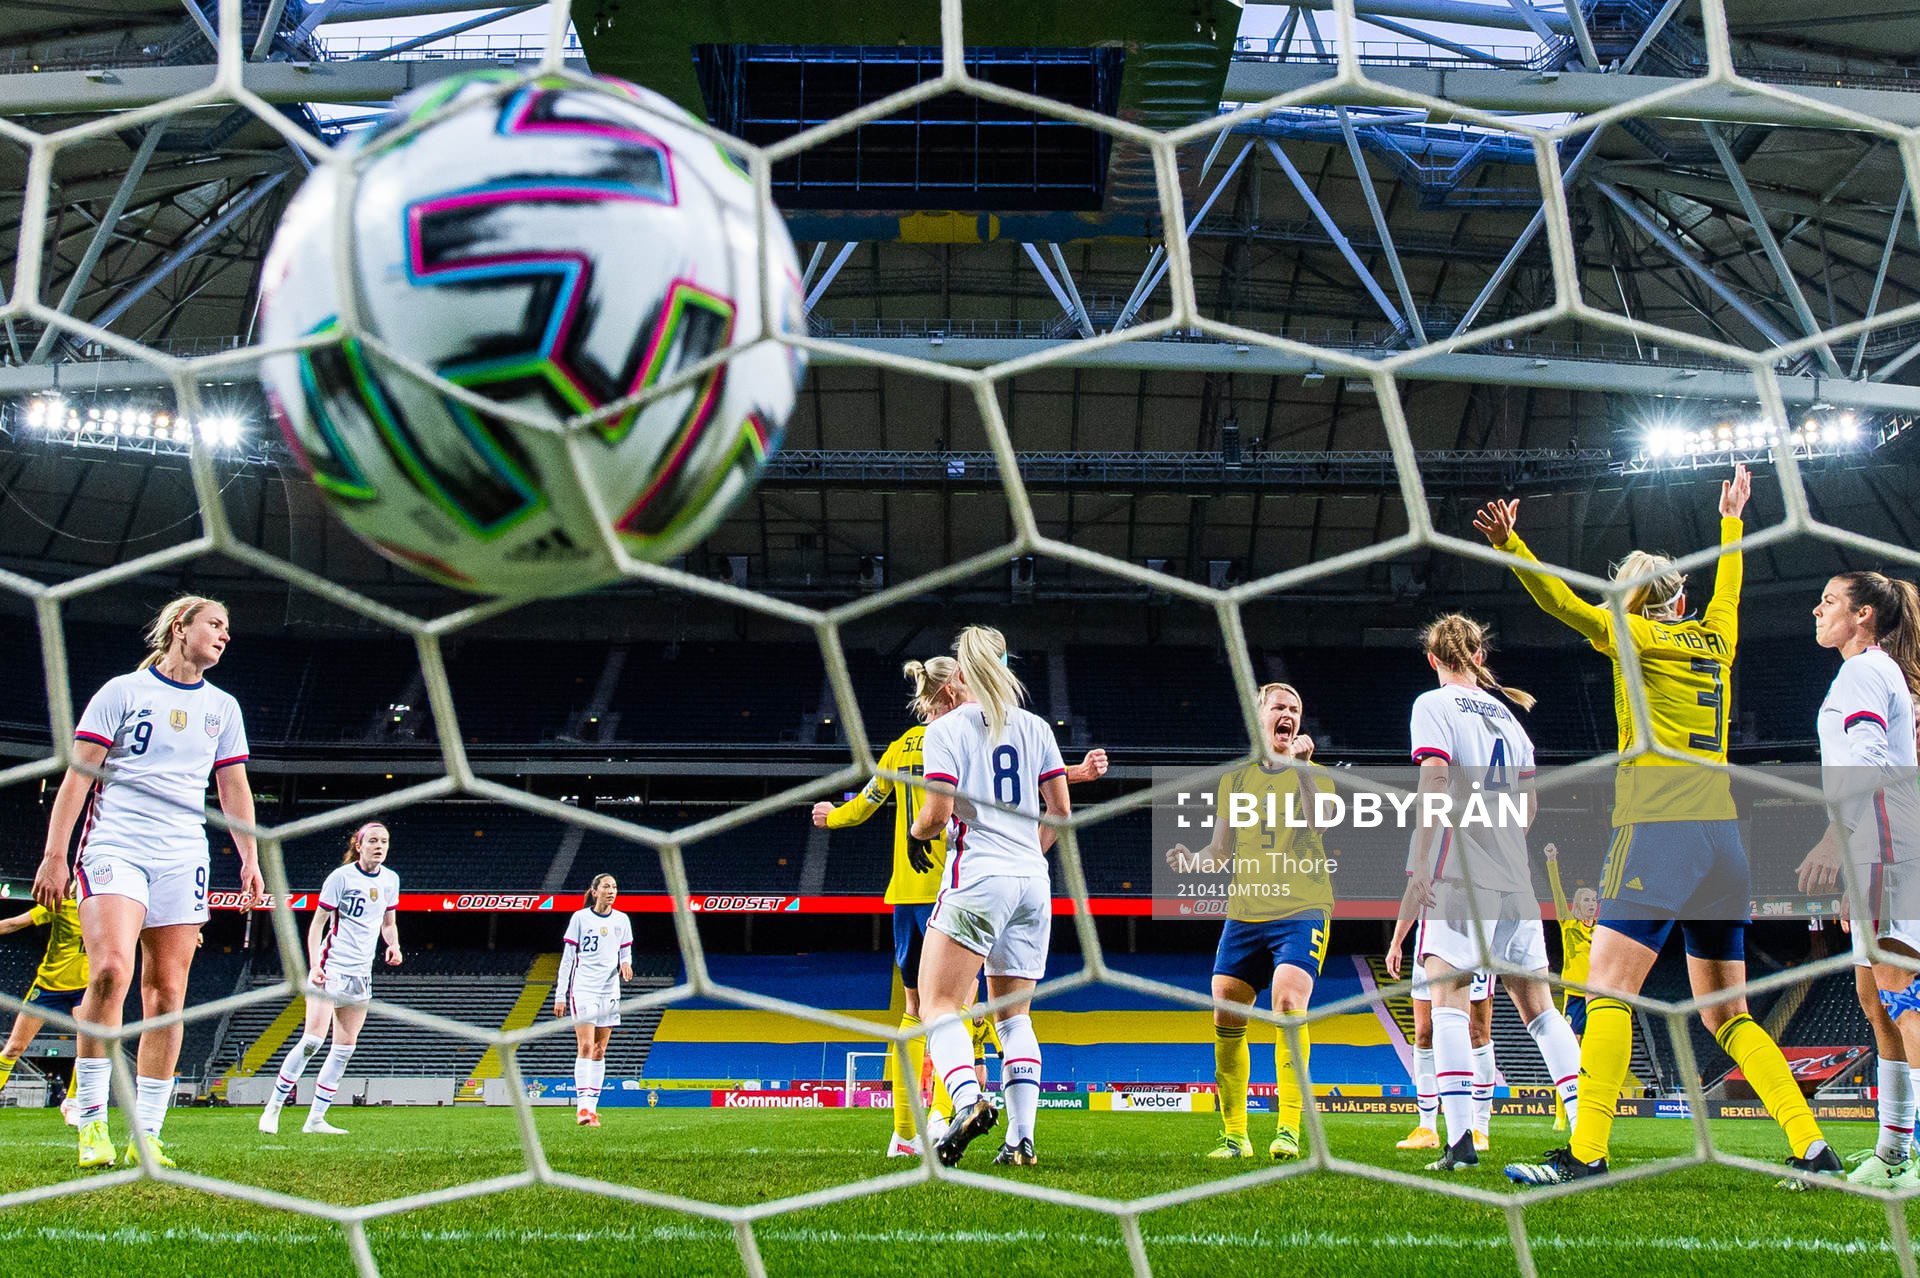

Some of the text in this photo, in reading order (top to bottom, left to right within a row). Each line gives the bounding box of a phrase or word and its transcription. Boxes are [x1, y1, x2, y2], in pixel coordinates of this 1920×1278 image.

[1689, 657, 1723, 751] 3
[131, 721, 153, 755] 9
[1484, 738, 1511, 791] 4
[992, 745, 1021, 809] 8
[194, 866, 206, 900] 9
[347, 897, 365, 917] 16
[457, 895, 538, 909] ODDSET
[704, 896, 785, 911] ODDSET
[1763, 902, 1793, 915] SWE
[583, 936, 598, 952] 23
[1309, 928, 1325, 960] 5
[870, 1093, 893, 1108] Fol
[1037, 1099, 1082, 1108] EPUMPAR
[1133, 1094, 1182, 1107] weber
[1332, 1101, 1387, 1113] HJÄLPER
[1389, 1102, 1419, 1113] SVEN
[1499, 1105, 1522, 1114] ATT
[1531, 1102, 1545, 1115] NÅ
[1720, 1106, 1756, 1117] REXEL
